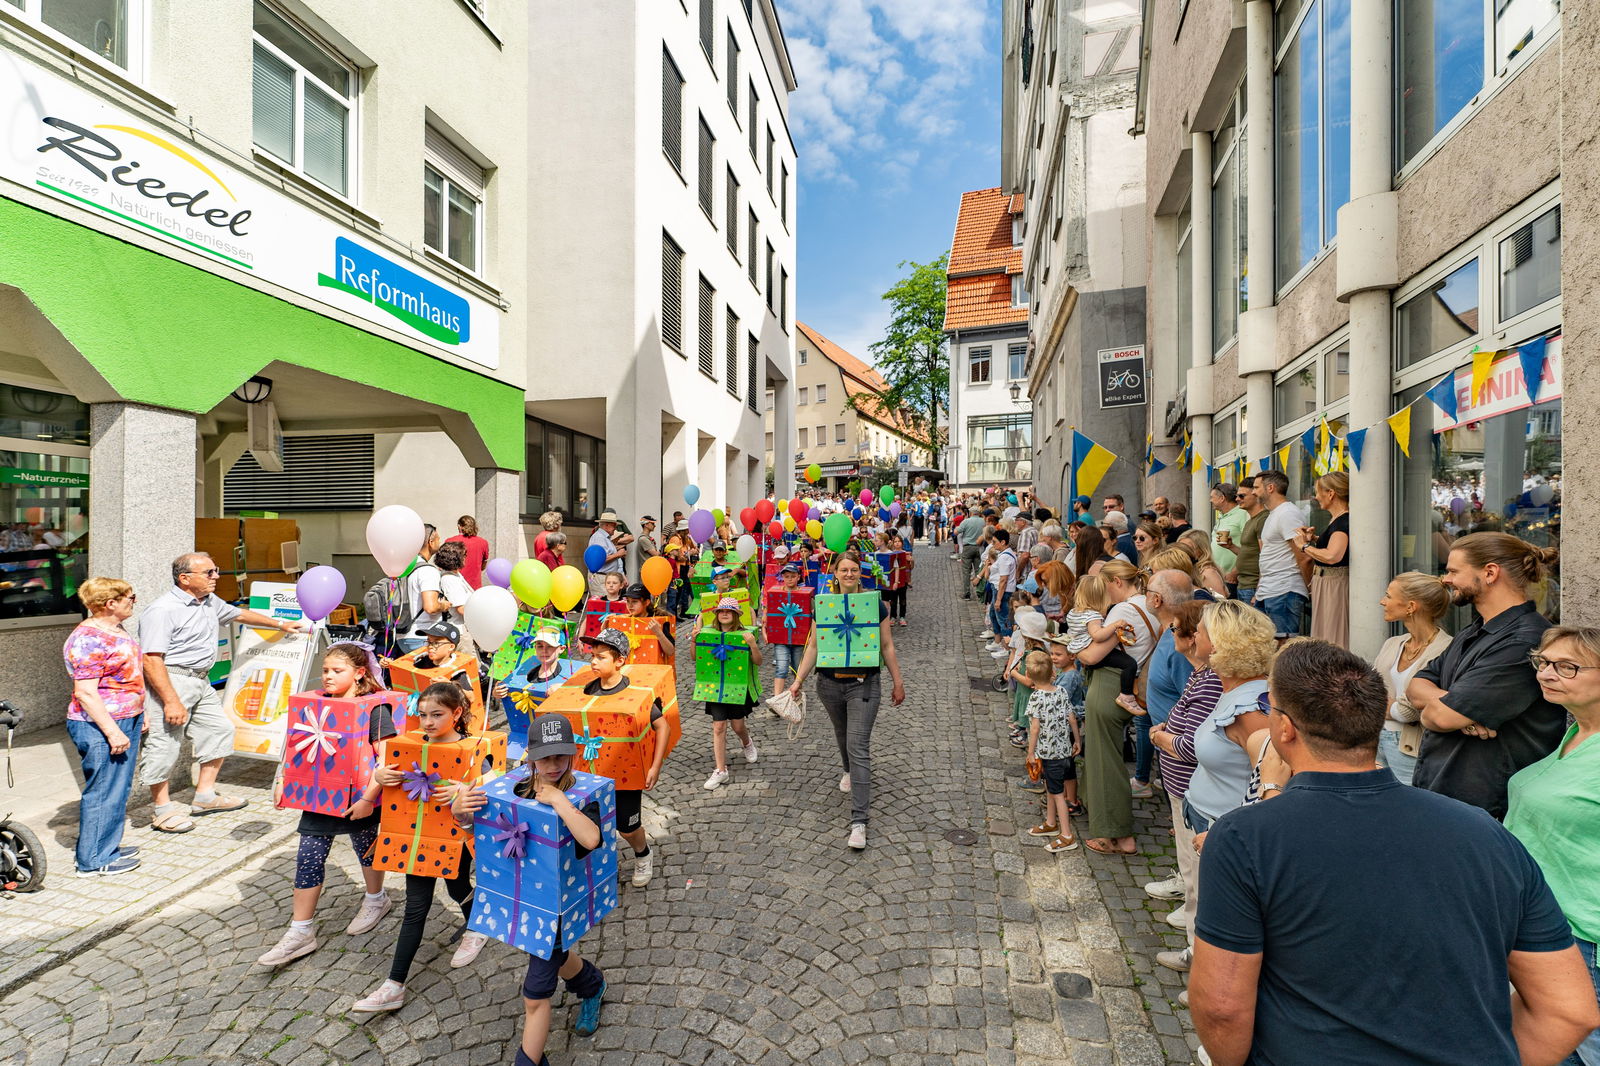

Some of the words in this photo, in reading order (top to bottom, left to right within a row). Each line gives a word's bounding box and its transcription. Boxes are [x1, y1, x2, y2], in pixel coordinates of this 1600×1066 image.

[36, 166, 66, 184] Seit
[68, 177, 100, 198] 1929
[37, 117, 252, 237] Riedel
[110, 191, 182, 233] Natürlich
[185, 226, 255, 262] geniessen
[340, 254, 461, 333] Reformhaus
[1114, 350, 1140, 359] BOSCH
[541, 720, 562, 736] HF
